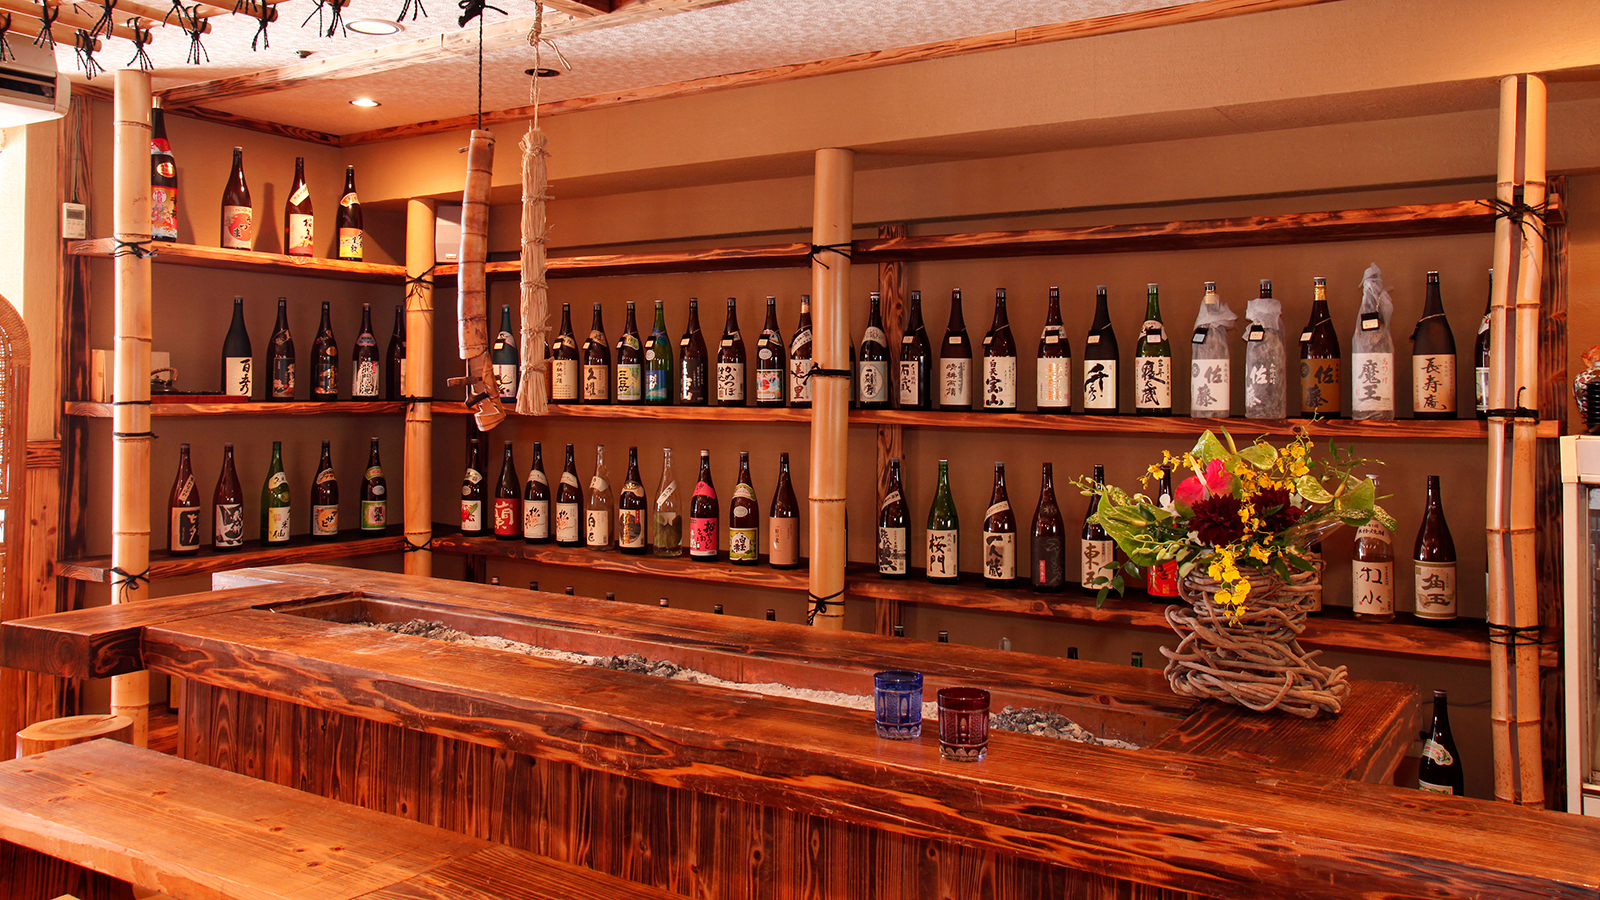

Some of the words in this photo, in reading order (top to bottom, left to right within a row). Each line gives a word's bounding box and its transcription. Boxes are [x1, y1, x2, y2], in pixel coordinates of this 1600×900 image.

[618, 370, 629, 392] 三岳
[724, 365, 737, 396] かめつぼ
[1196, 365, 1223, 407] 佐藤
[1246, 364, 1268, 408] 佐藤
[1306, 365, 1334, 407] 佐藤
[1357, 359, 1381, 402] 魔王
[703, 520, 716, 549] おやっと
[929, 534, 947, 574] 桜門
